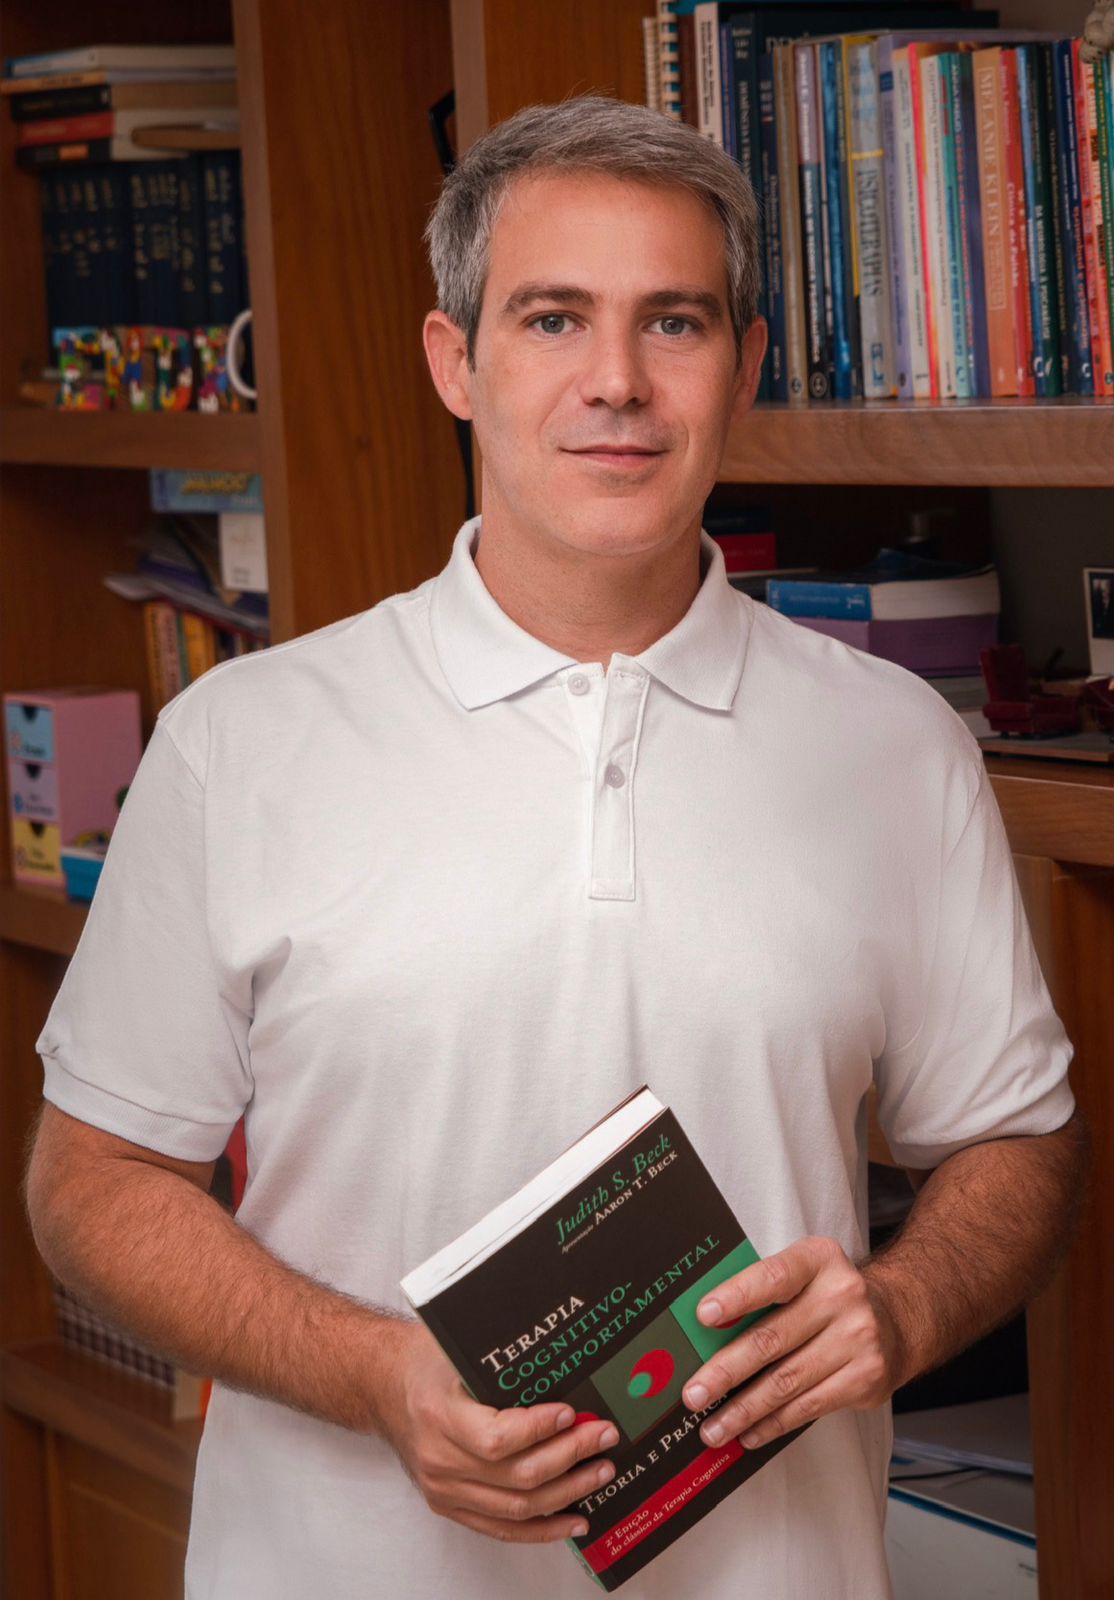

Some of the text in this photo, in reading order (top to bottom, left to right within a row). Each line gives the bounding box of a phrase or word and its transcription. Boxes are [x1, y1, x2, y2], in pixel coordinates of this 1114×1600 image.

[799, 53, 809, 86] David
[927, 63, 938, 124] Psiquiatria
[950, 64, 960, 97] ANNA
[953, 98, 962, 133] FREUD
[980, 71, 997, 166] MELANIE
[804, 170, 814, 215] MANUAL
[986, 173, 1001, 236] KLEIN
[1035, 205, 1044, 218] DA
[806, 218, 815, 233] DE
[857, 169, 884, 297] PSICOTERAPIAS
[1007, 182, 1020, 288] Clínica da Pulsão
[1019, 225, 1027, 251] Bion
[1036, 220, 1048, 272] NEUROLOGIA
[1073, 206, 1085, 270] psiquiatria
[807, 235, 817, 282] TÉCNICA
[1040, 285, 1051, 340] PSICANÁLISE
[1076, 282, 1088, 349] Introdução
[556, 1134, 671, 1245] Judith S. Beck
[594, 1188, 633, 1225] AARON
[631, 1176, 648, 1190] T.
[647, 1150, 679, 1179] BECK
[481, 1295, 585, 1373] TERAPIA
[498, 1281, 633, 1391] COGNITIVO-
[513, 1234, 721, 1408] -COMPORTAMENTAL
[579, 1463, 647, 1515] TEORIA
[647, 1450, 660, 1465] E
[611, 1453, 731, 1556] do clássico da Terapia Cognitiva
[615, 1509, 650, 1539] EDIÇÃO
